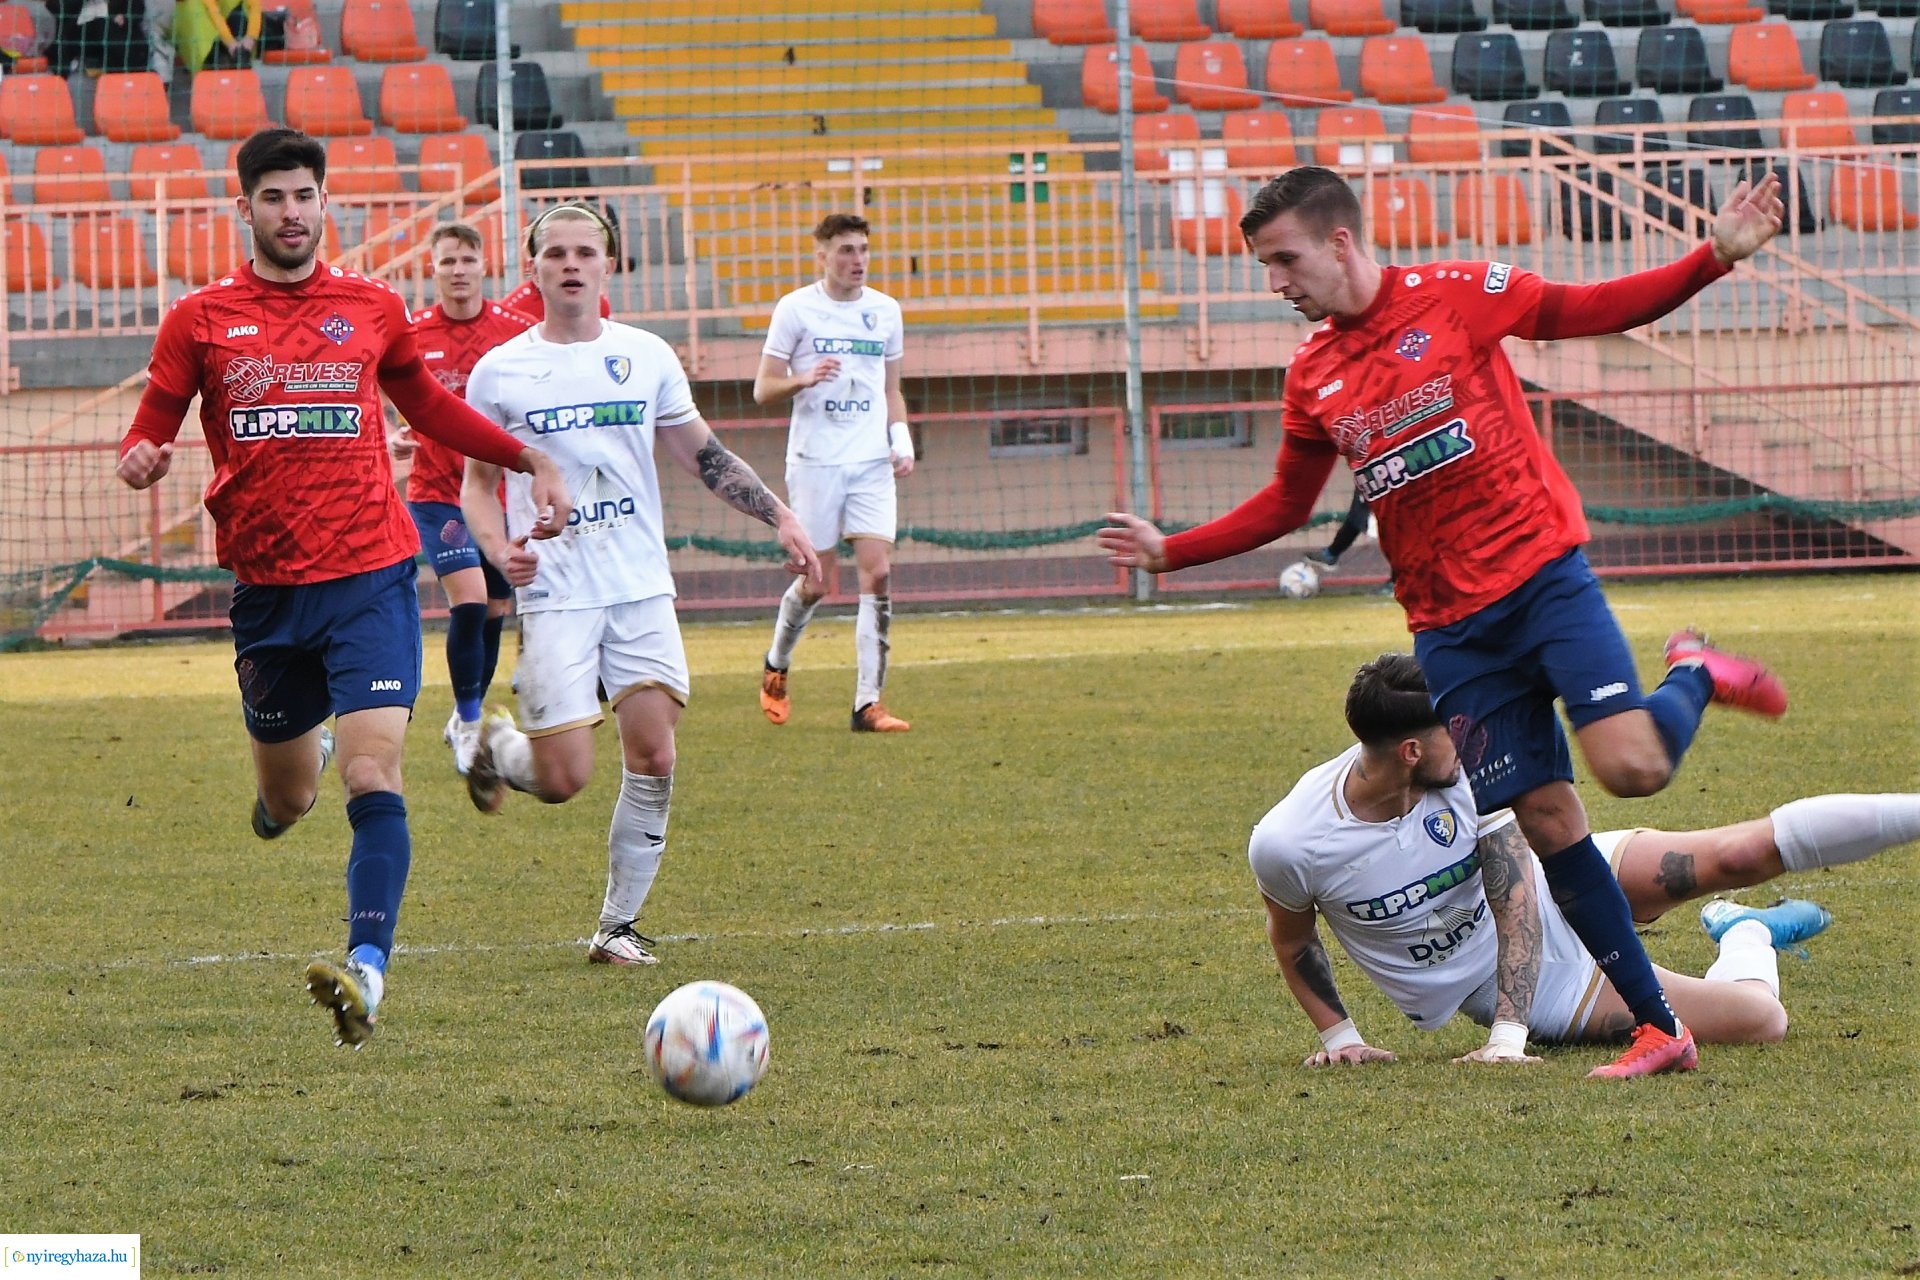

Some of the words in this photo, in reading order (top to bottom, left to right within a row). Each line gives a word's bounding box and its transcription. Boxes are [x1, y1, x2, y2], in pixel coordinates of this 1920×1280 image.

[226, 325, 259, 339] JAKO
[273, 362, 362, 382] REVESZ
[527, 402, 645, 433] TiPPMIX
[1366, 374, 1452, 432] REVESZ
[231, 407, 360, 437] TiPPMIX
[1354, 424, 1470, 500] TiPPMIX
[370, 679, 402, 691] JAKO
